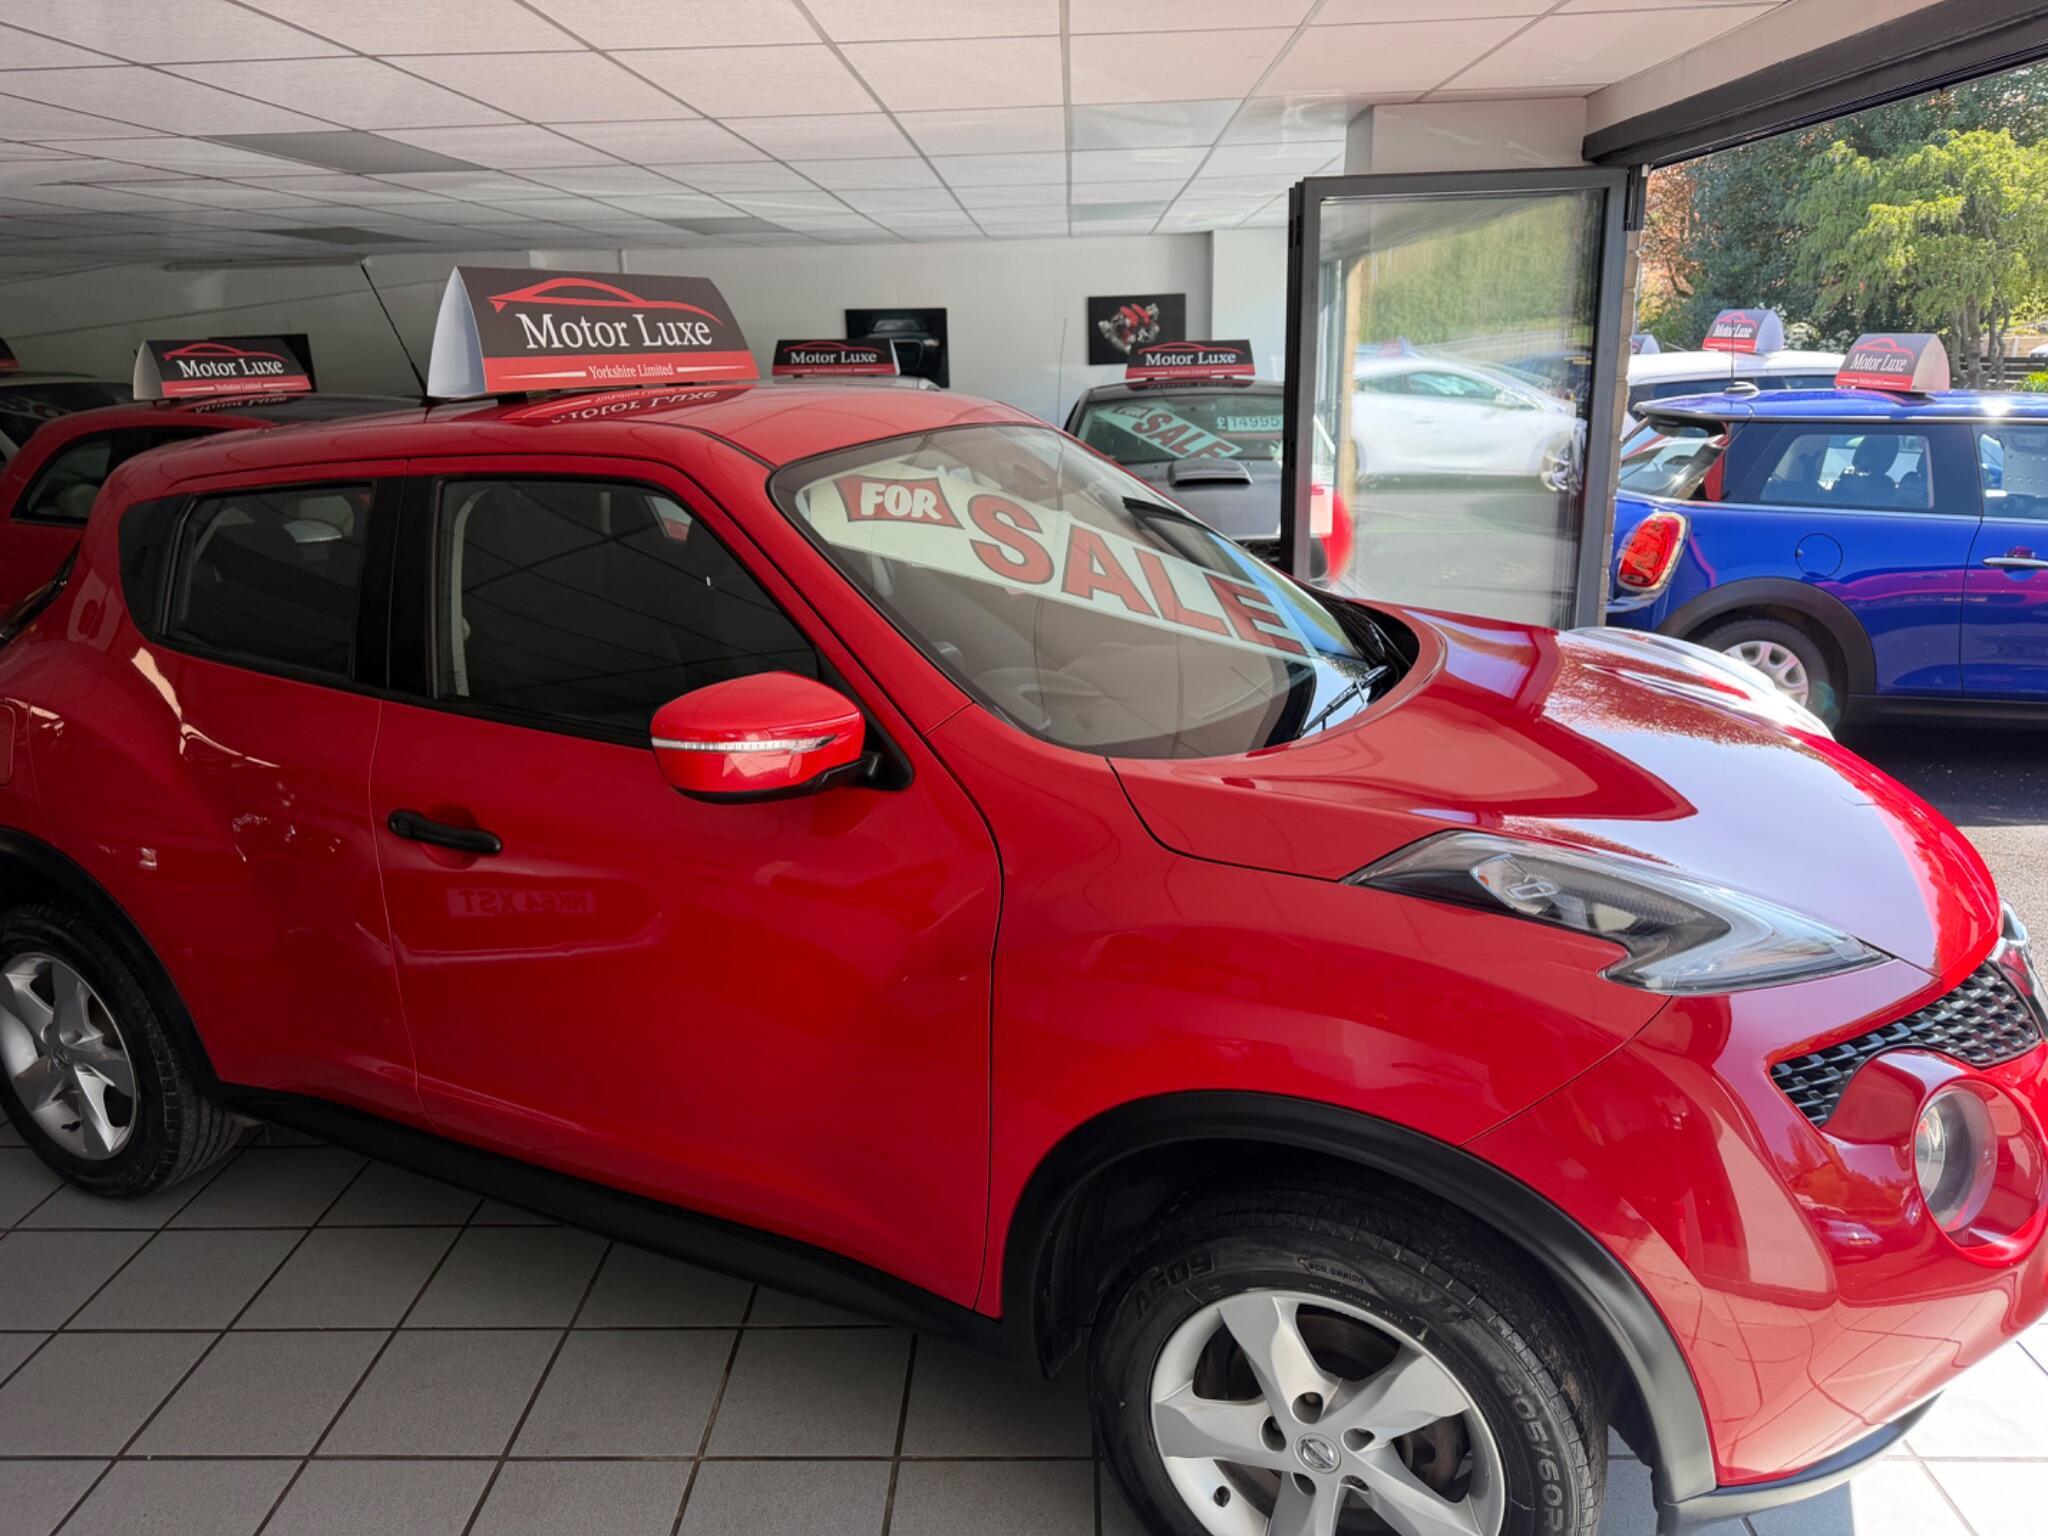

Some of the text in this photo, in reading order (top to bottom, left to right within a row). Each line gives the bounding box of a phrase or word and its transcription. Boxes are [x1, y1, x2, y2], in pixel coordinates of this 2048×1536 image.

[515, 313, 713, 350] Motor Luxe
[791, 351, 878, 364] Motor Luxe
[1145, 351, 1237, 367] Motor Luxe
[1850, 354, 1907, 372] Motor Luxe
[176, 358, 285, 378] Motor Luxe
[588, 363, 674, 380] Yorkshire Limited
[859, 481, 1308, 657] FOR SALE
